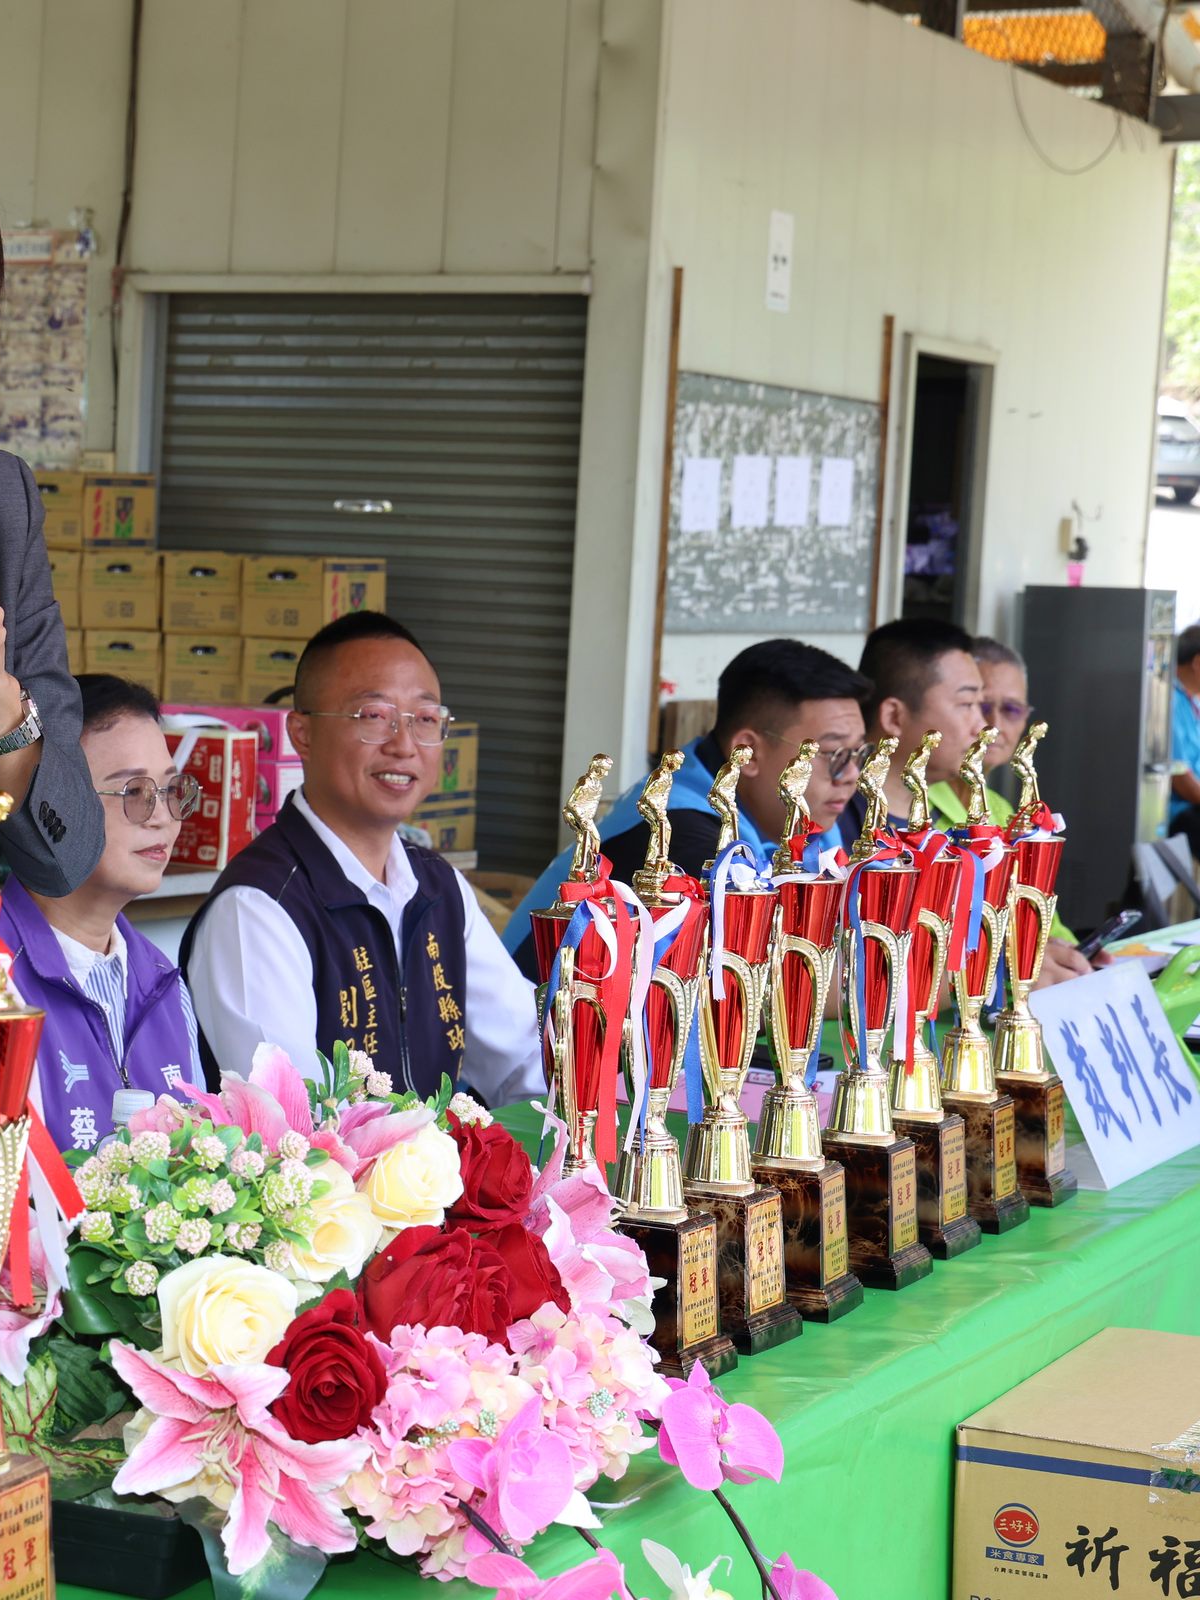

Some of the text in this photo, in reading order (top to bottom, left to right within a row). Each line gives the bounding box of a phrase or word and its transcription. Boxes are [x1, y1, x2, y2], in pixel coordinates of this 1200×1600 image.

[352, 946, 379, 1055] 駐區主任
[426, 931, 465, 1081] 南投縣政
[1059, 994, 1193, 1142] 裁判長
[70, 1107, 98, 1150] 蔡
[998, 1518, 1035, 1534] 三好米
[2, 1536, 38, 1581] 冠軍
[990, 1549, 1039, 1564] 米食專家
